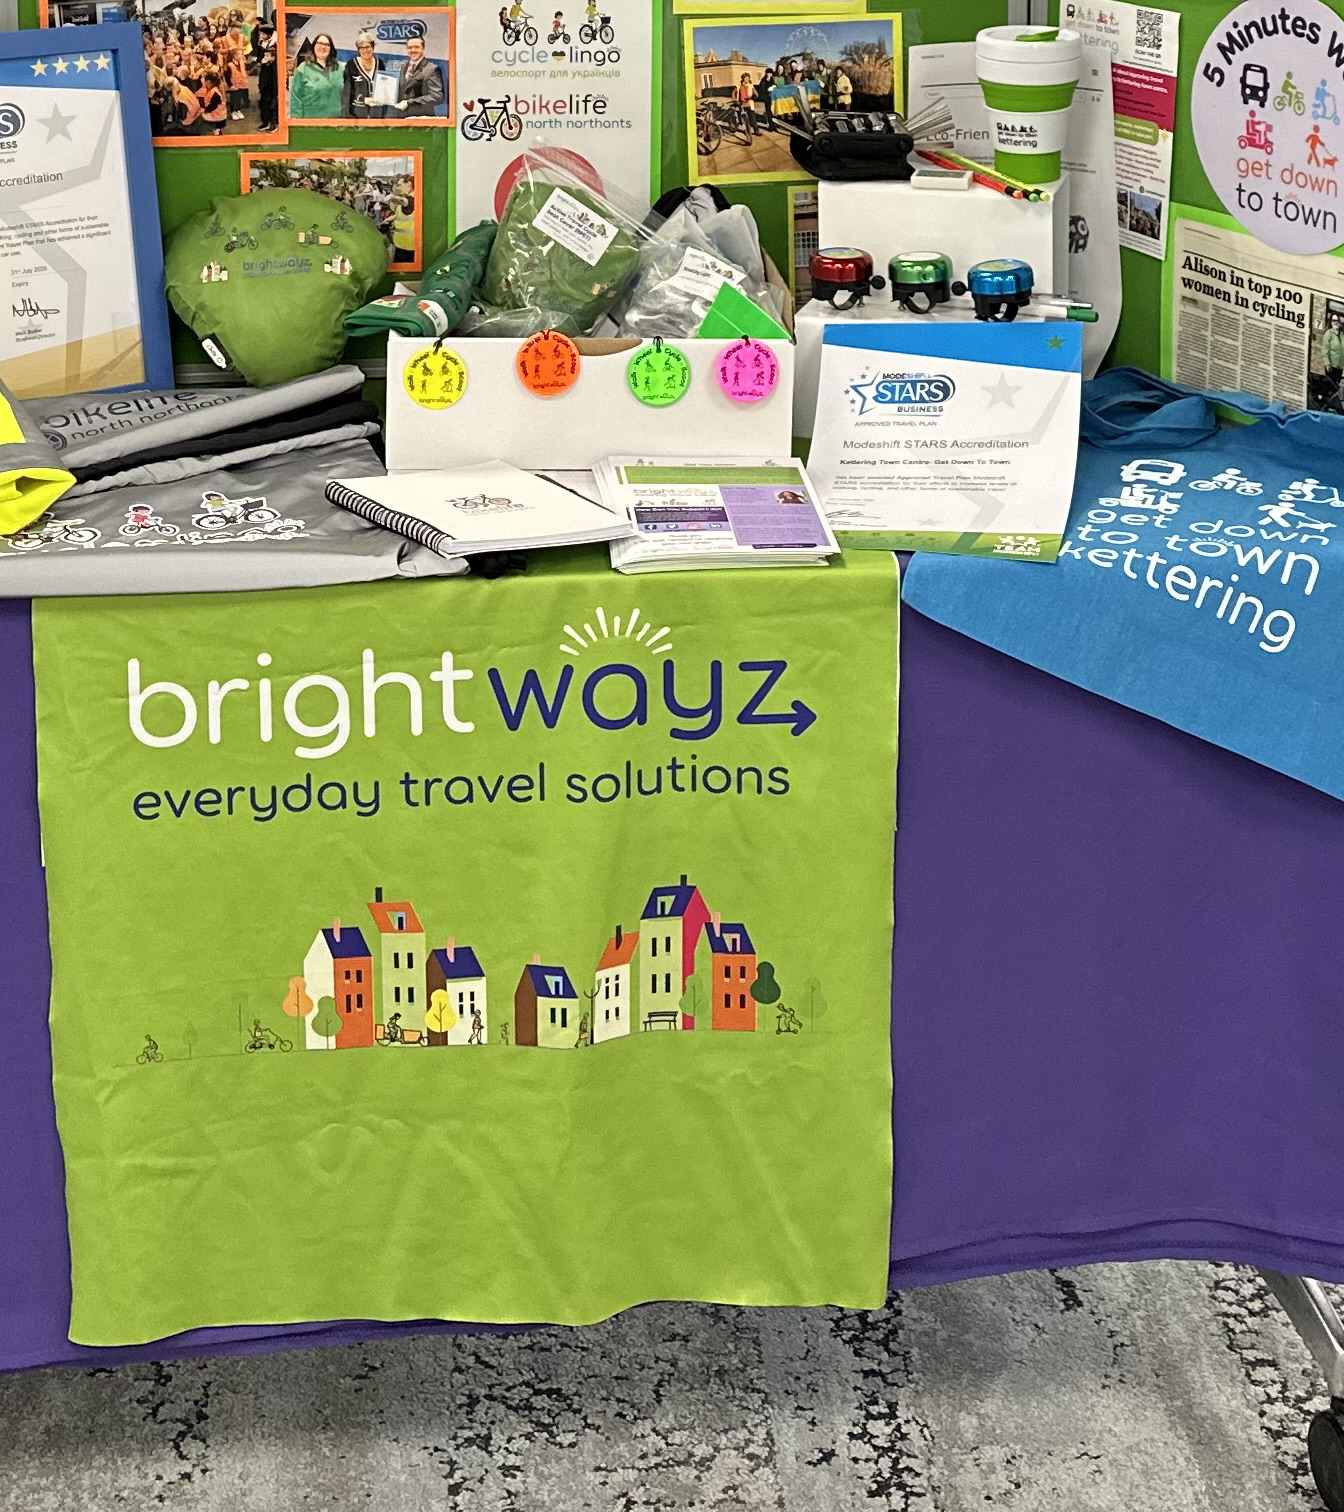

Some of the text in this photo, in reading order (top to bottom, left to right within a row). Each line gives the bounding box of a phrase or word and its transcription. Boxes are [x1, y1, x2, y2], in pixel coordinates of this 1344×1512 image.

[491, 46, 621, 66] cycle lingo
[1204, 62, 1225, 87] 5
[1217, 7, 1321, 66] Minutes
[514, 93, 608, 115] bikelife
[525, 117, 633, 130] north northants
[1236, 156, 1338, 198] get down
[1236, 182, 1337, 233] to town
[1182, 255, 1303, 306] Alison in top 100
[1181, 277, 1305, 328] women in cycling
[877, 382, 944, 402] STARS
[897, 405, 944, 413] BUSINESS
[72, 419, 133, 440] north
[843, 439, 1030, 449] Modeshift STARS Accreditation
[1086, 508, 1330, 546] get down
[1077, 525, 1320, 595] to town
[1059, 541, 1296, 653] kettering
[132, 754, 790, 823] everyday travel solutions
